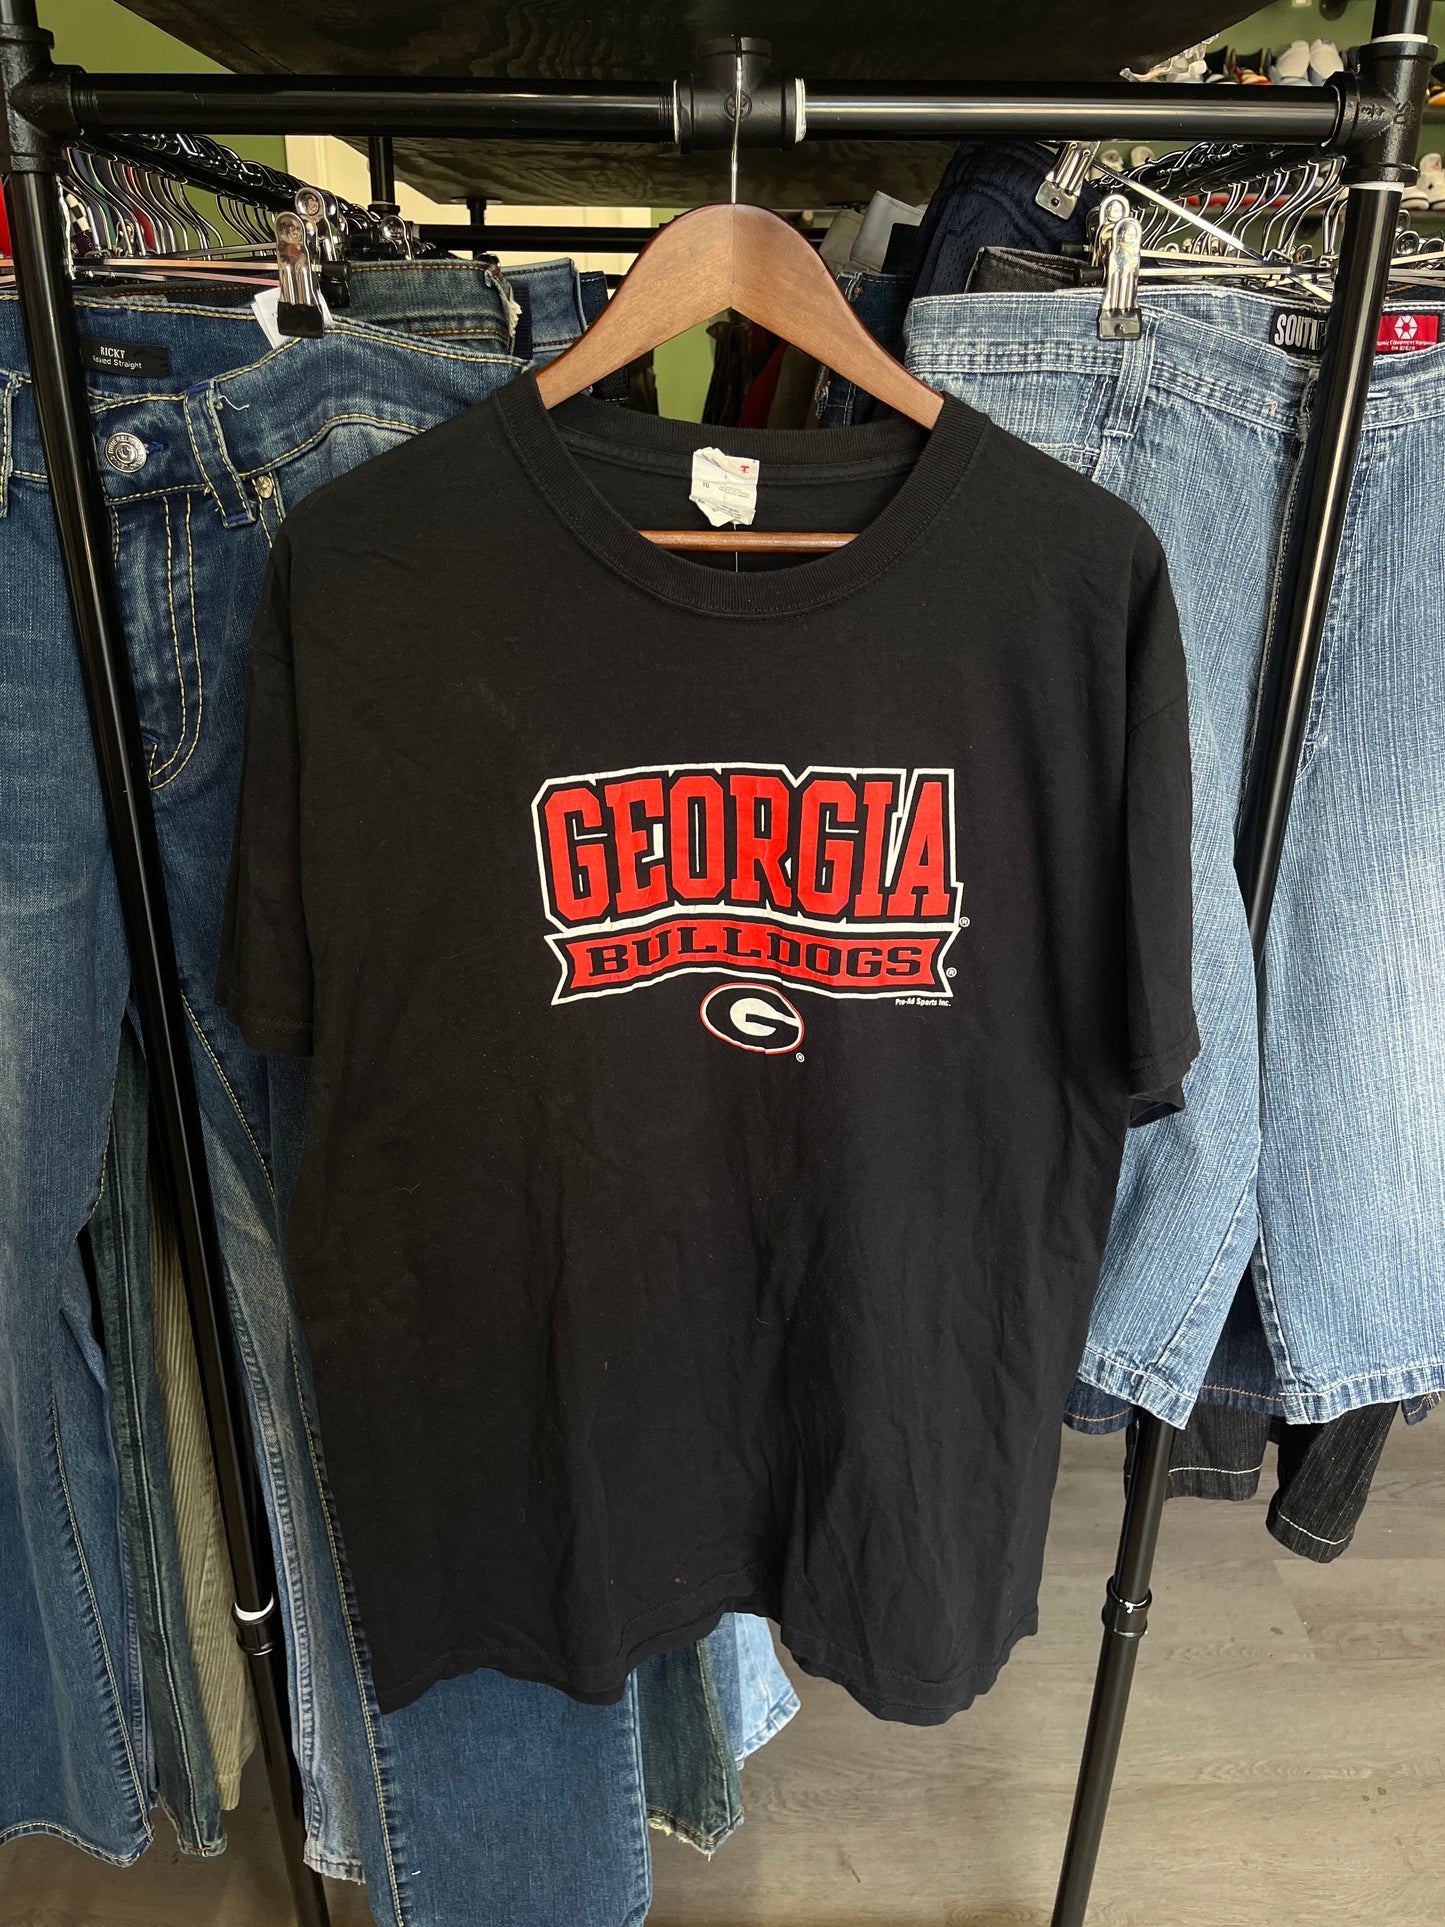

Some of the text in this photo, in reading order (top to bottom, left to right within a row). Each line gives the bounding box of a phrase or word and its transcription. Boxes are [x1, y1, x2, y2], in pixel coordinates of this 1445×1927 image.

[100, 346, 125, 359] RICKY
[113, 358, 142, 370] Straight
[545, 775, 949, 920] GEORGIA
[586, 926, 922, 977] BULLDOGS
[916, 997, 938, 1007] Sports
[938, 998, 952, 1007] Inc.
